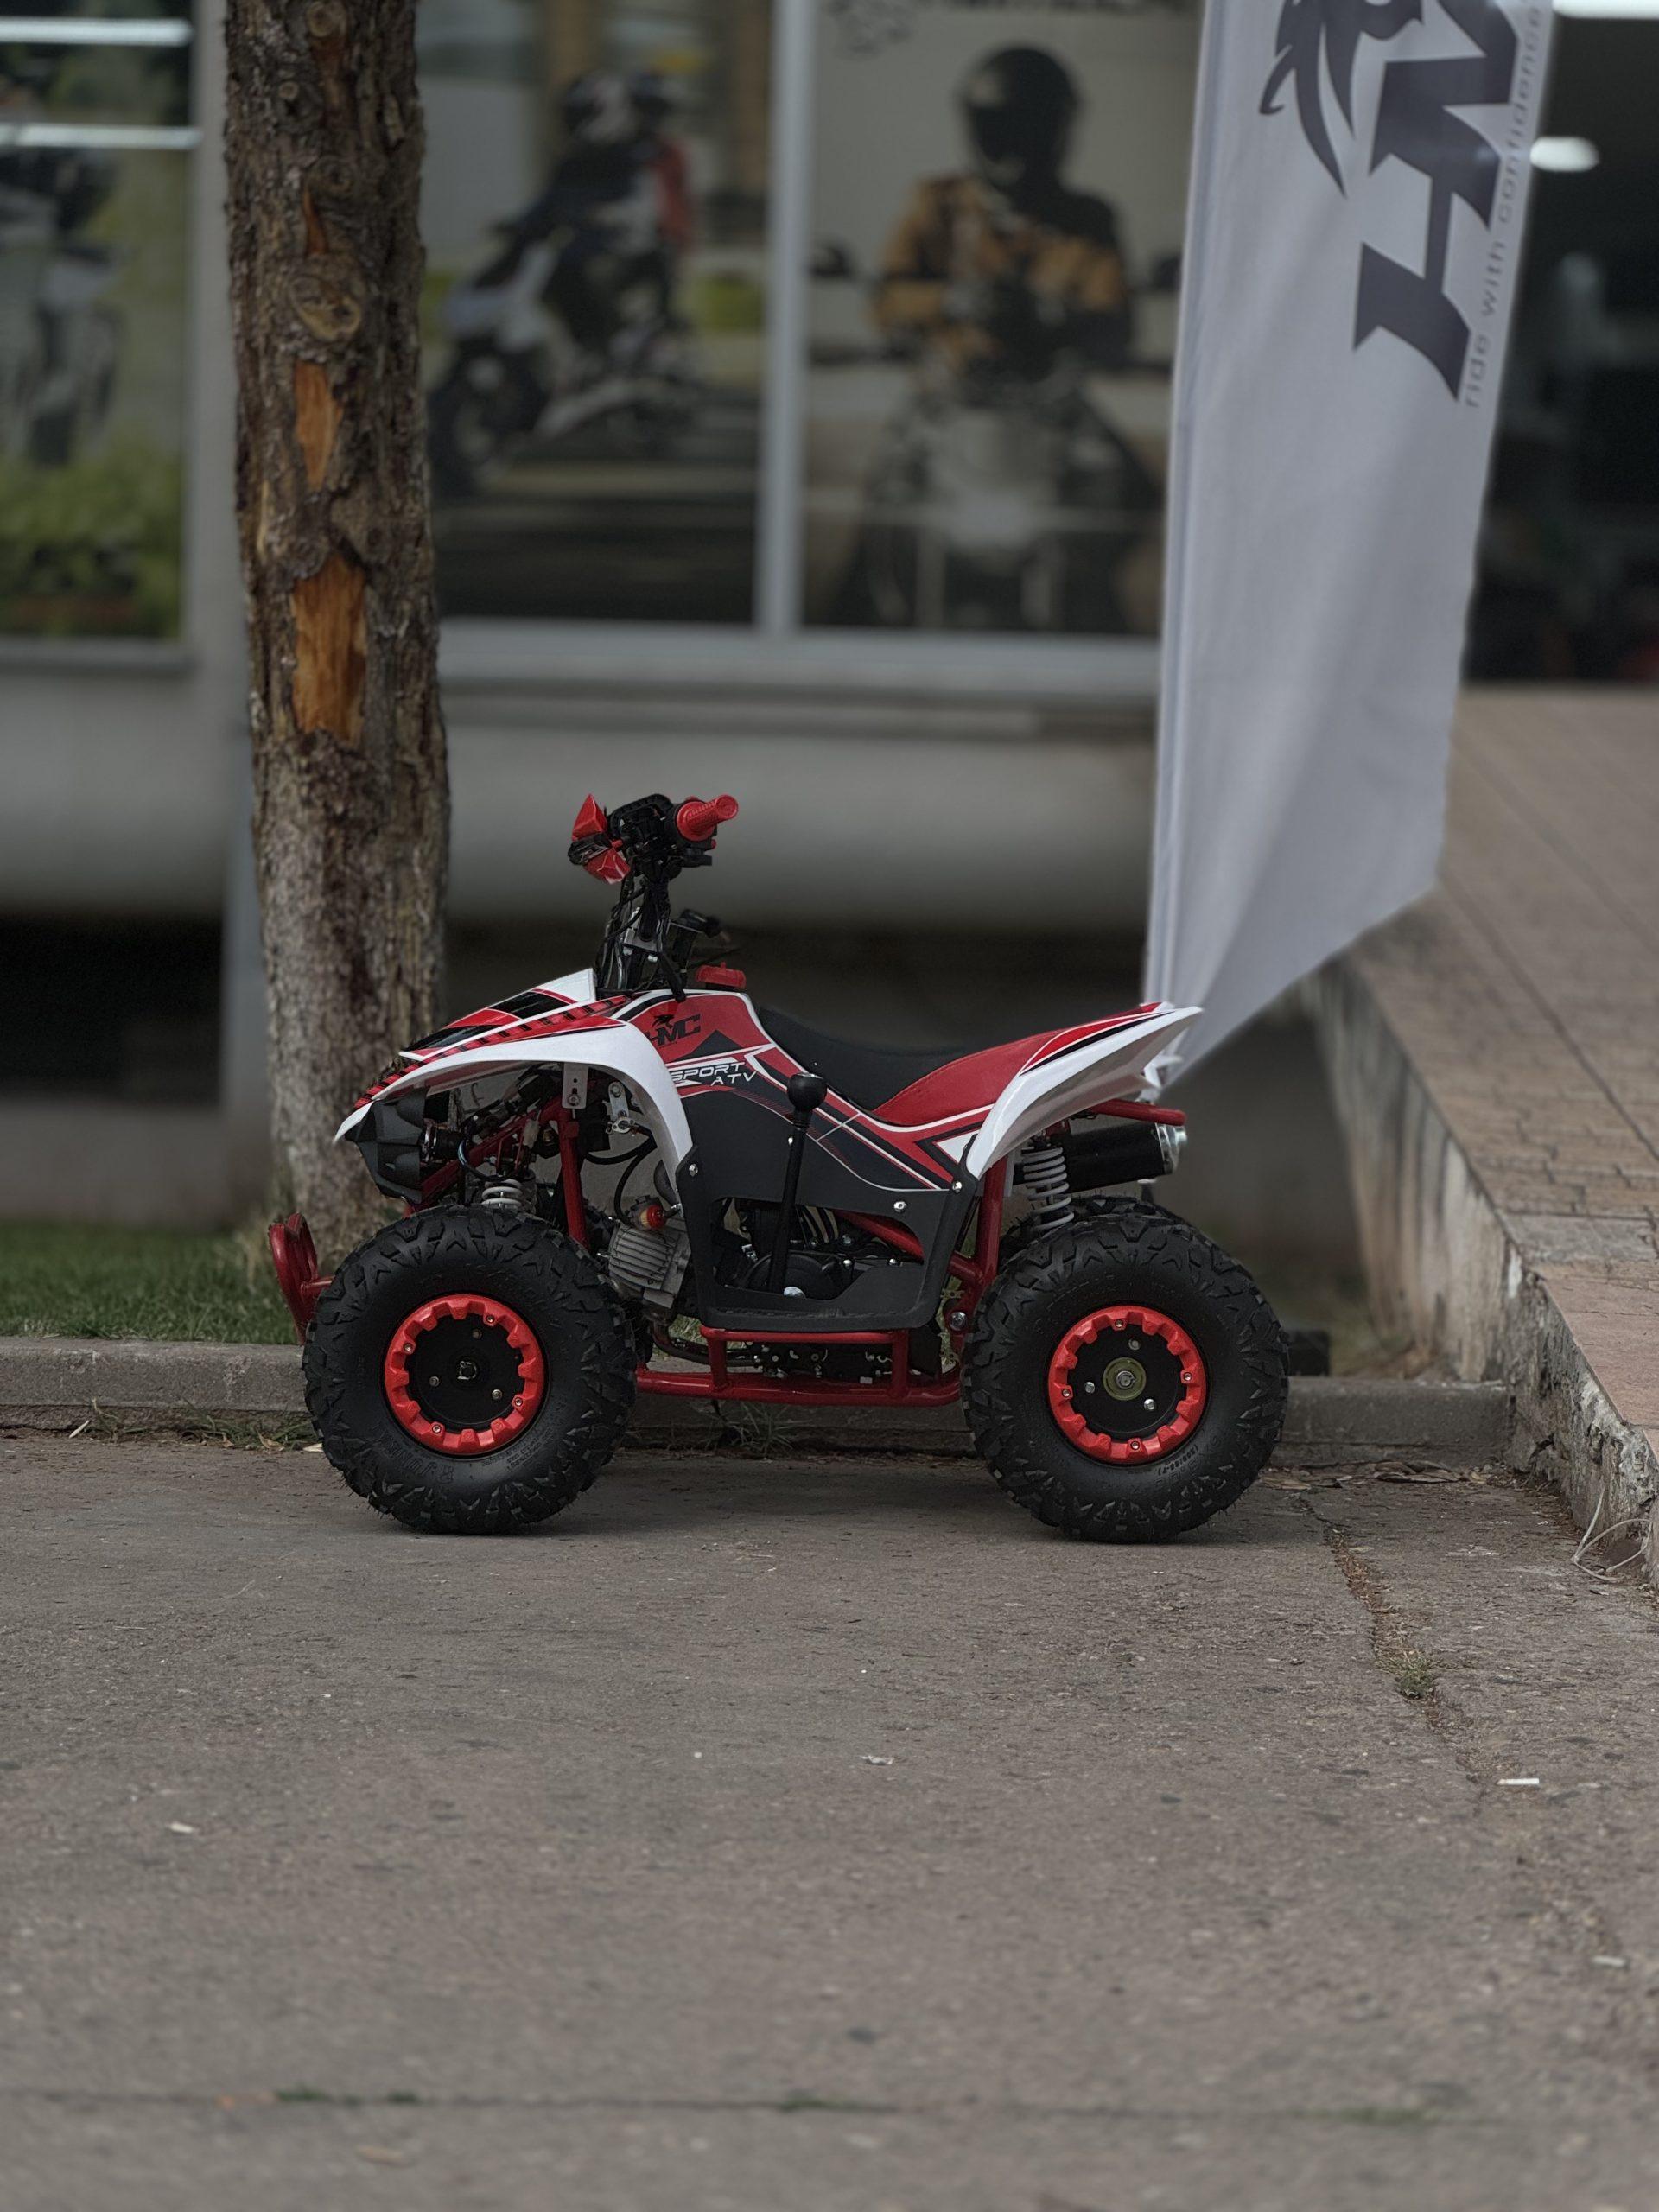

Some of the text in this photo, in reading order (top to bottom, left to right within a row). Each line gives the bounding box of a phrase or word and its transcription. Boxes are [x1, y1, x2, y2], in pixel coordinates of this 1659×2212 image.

[1464, 5, 1542, 409] ride with confidence
[670, 1061, 746, 1082] SPORT
[710, 1071, 757, 1087] ATV
